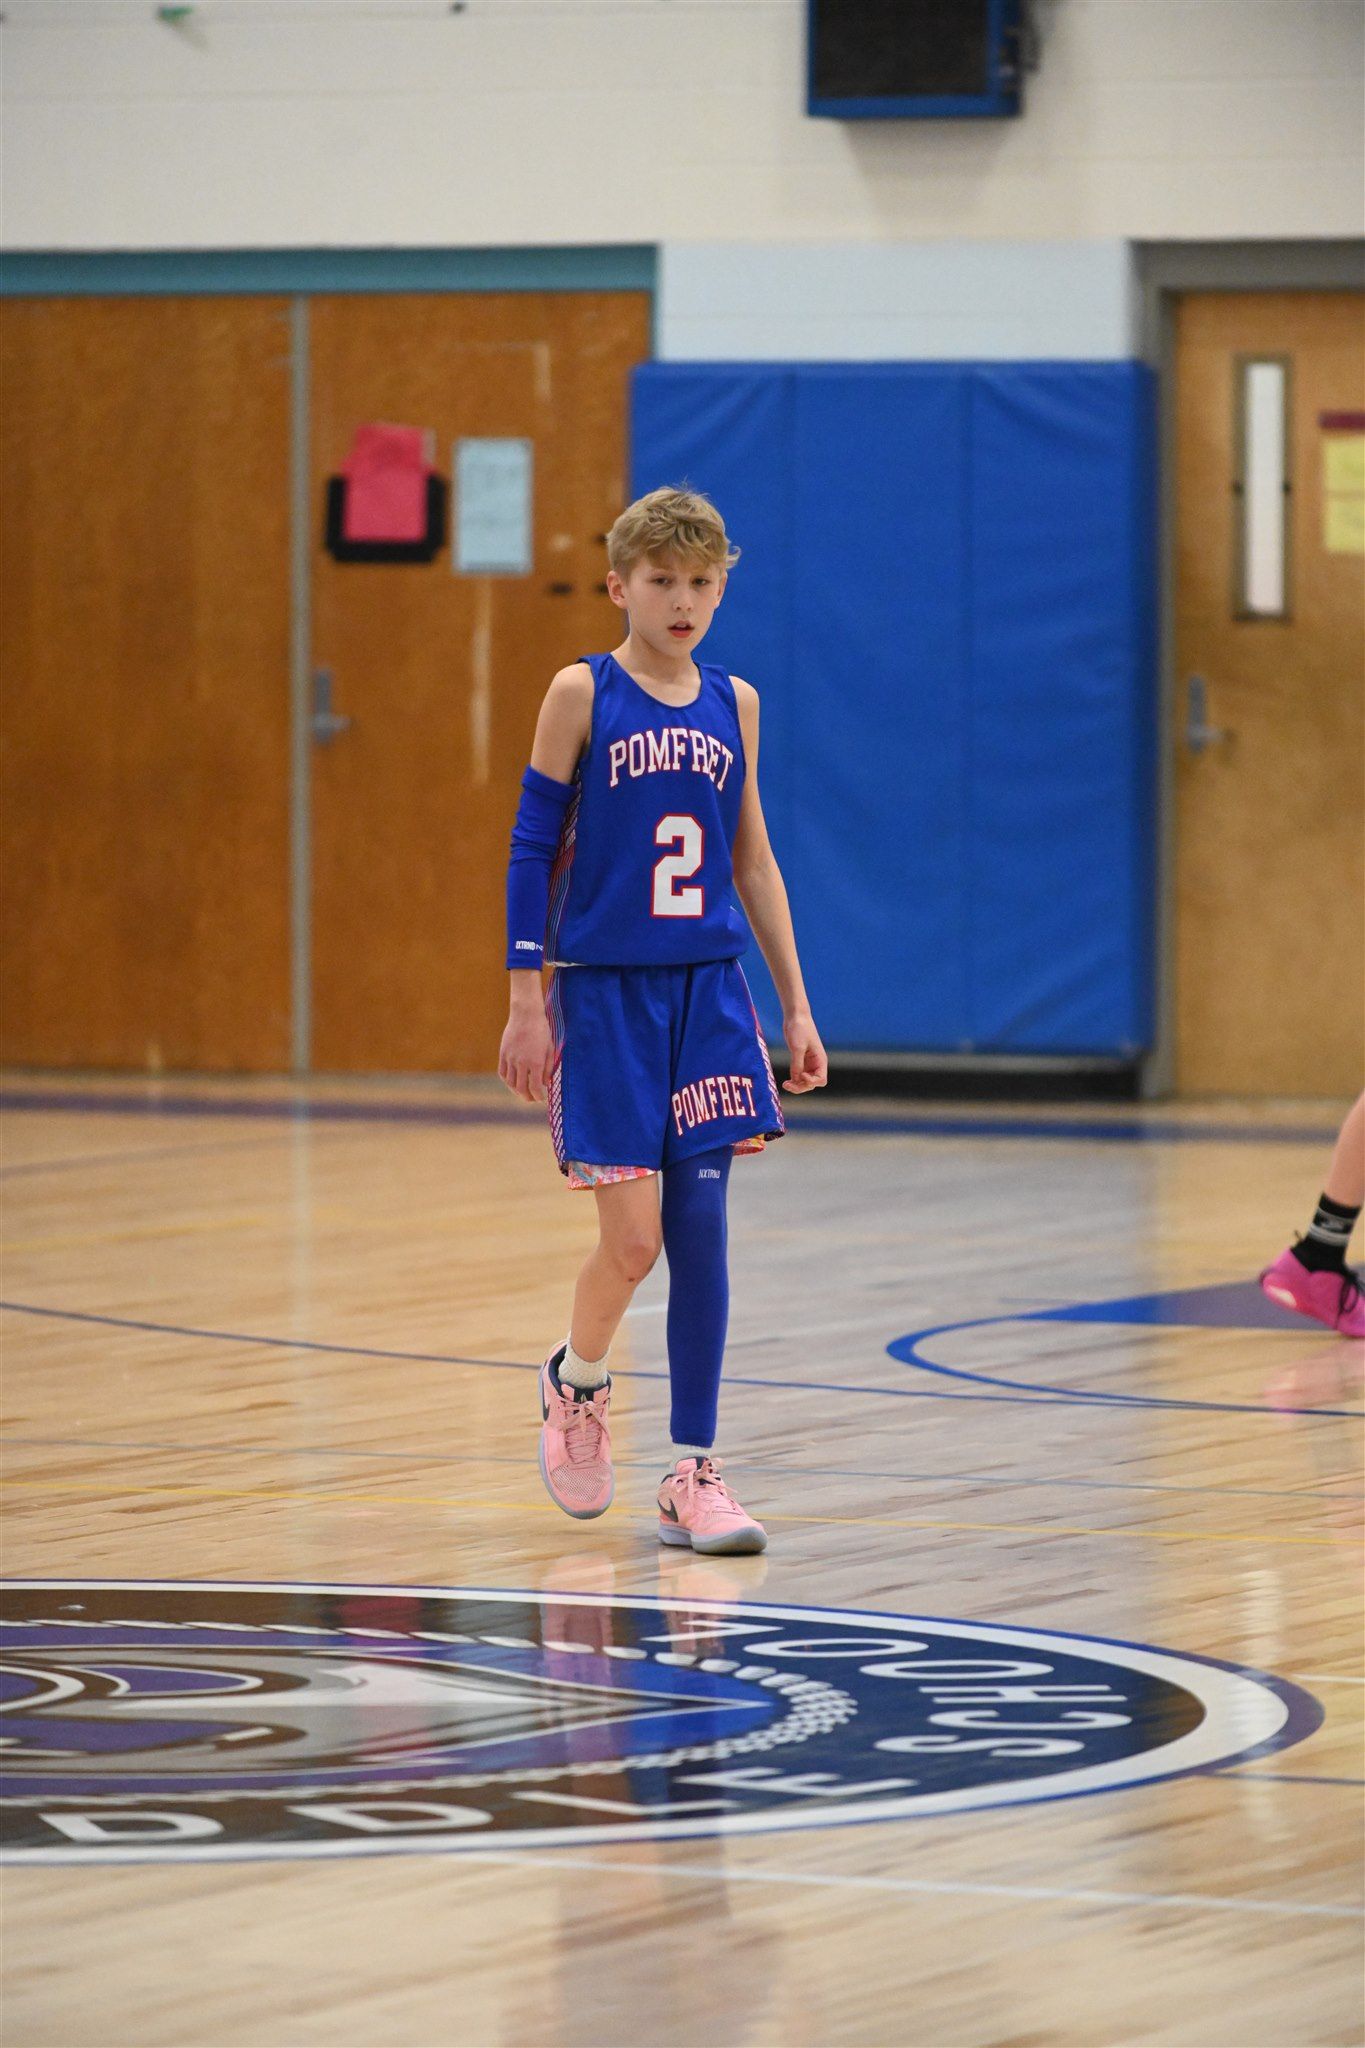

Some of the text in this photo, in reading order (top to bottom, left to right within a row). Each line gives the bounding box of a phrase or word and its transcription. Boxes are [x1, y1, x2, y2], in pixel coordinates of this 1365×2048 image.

[609, 727, 734, 792] POMFRET
[652, 814, 703, 917] 2
[671, 1075, 757, 1136] POMFRET
[639, 1618, 1133, 1758] SCHOOL
